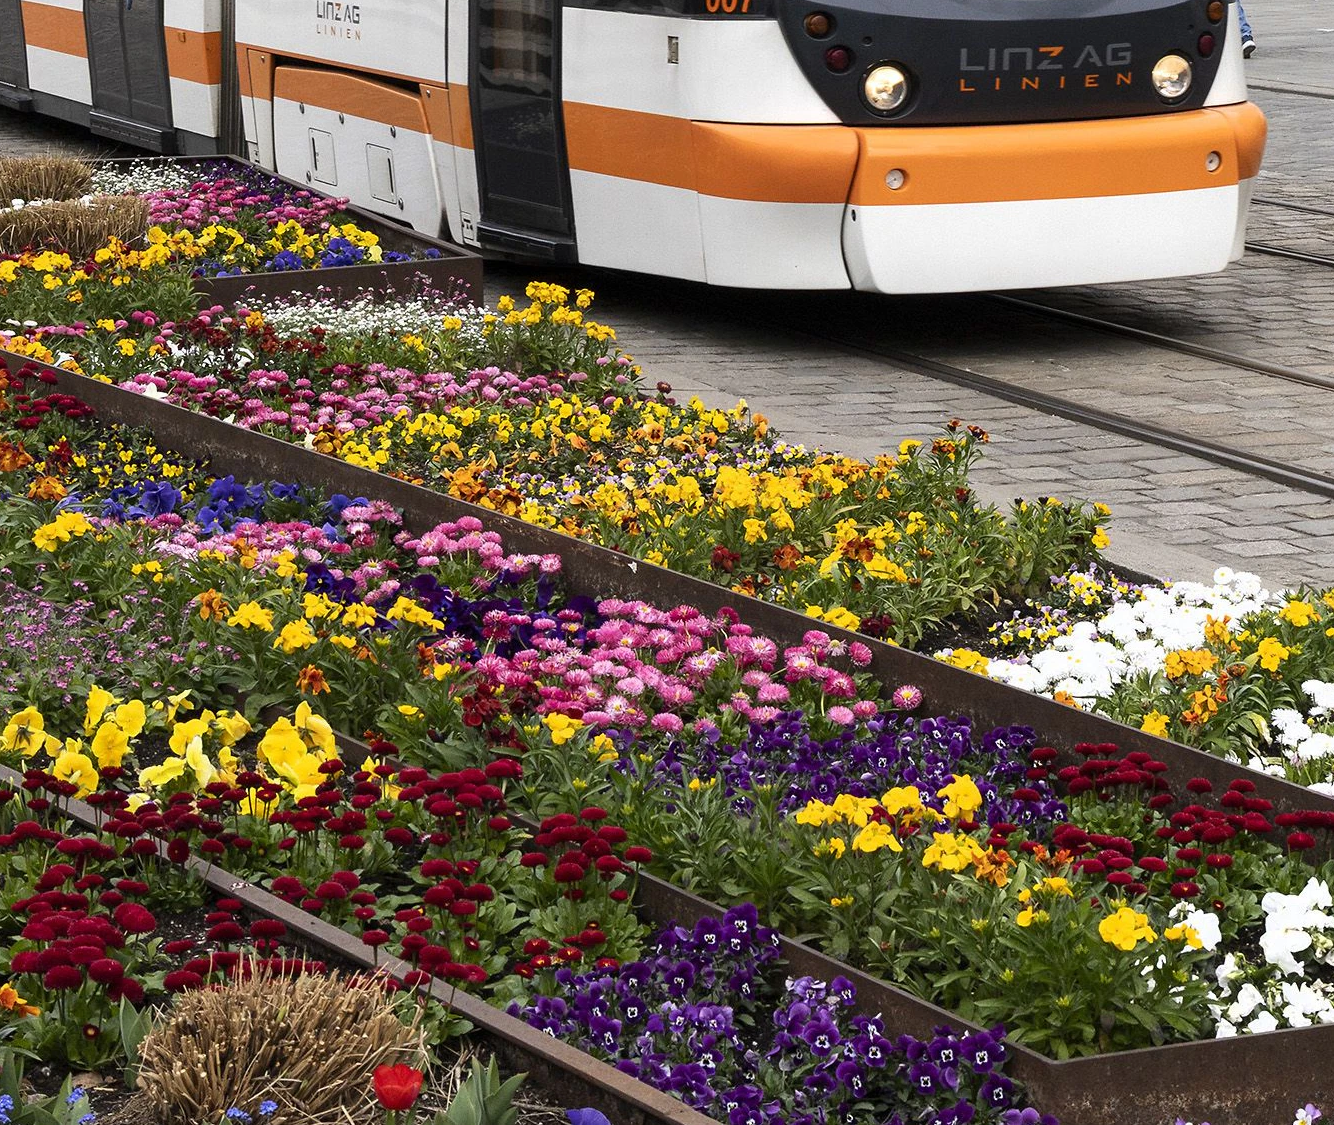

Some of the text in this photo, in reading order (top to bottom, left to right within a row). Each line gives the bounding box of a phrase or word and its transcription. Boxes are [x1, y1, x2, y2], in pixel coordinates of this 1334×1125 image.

[317, 0, 360, 24] LINZ AG
[316, 24, 361, 40] LINIEN
[960, 42, 1132, 71] LINZ AG
[960, 71, 1133, 92] LINIEN
